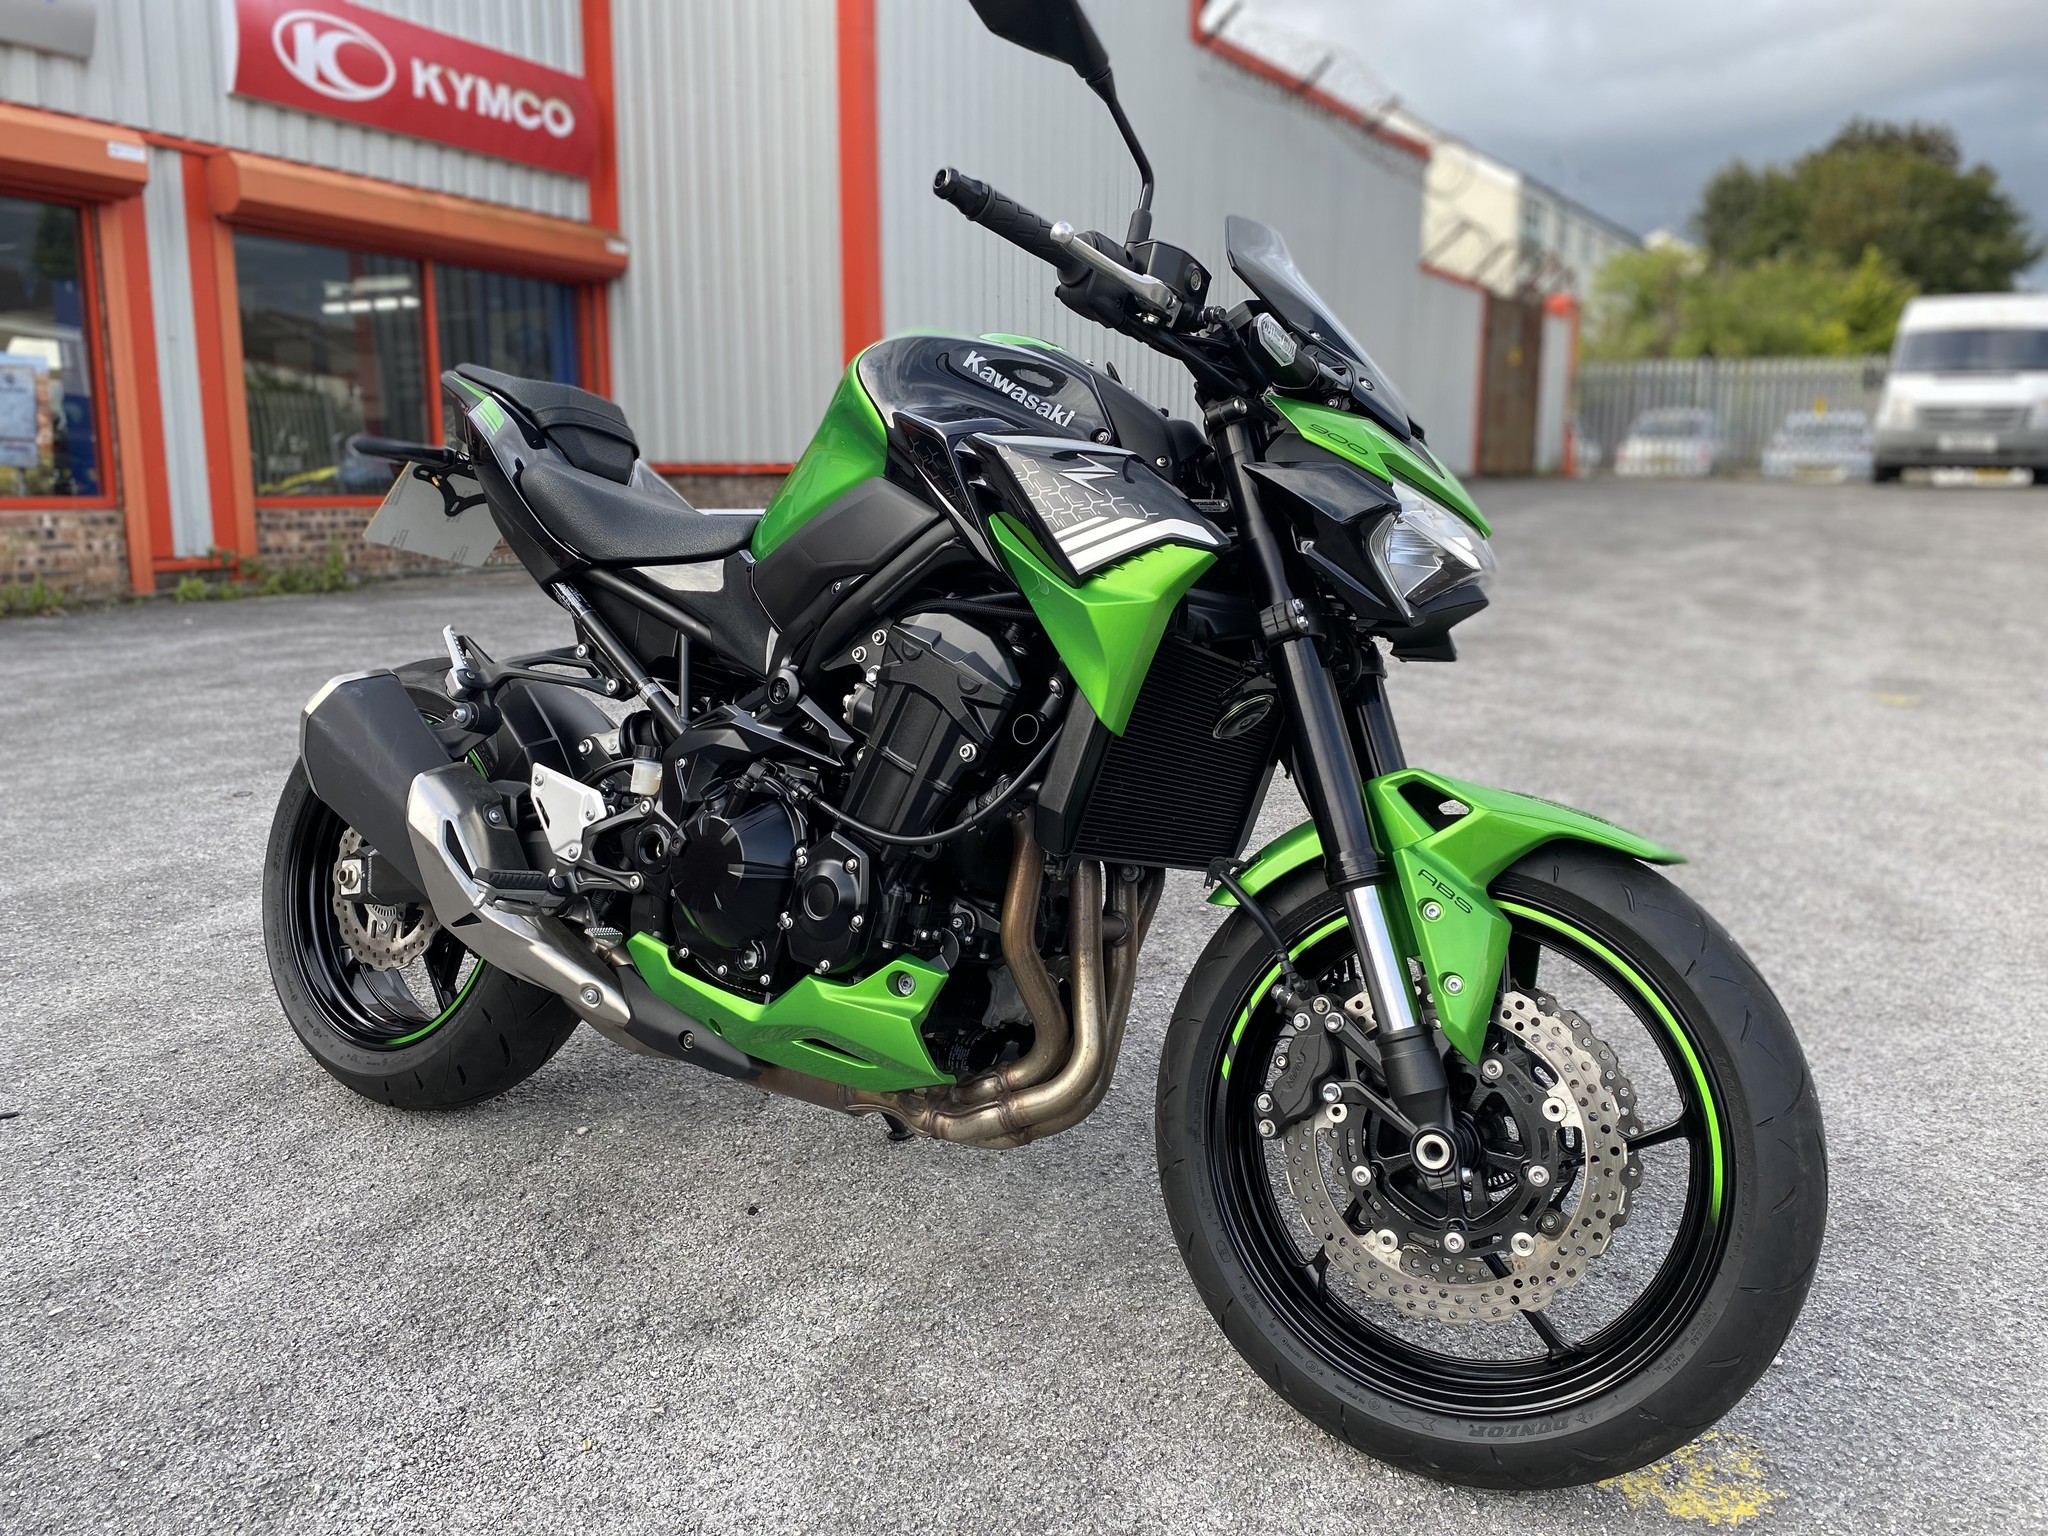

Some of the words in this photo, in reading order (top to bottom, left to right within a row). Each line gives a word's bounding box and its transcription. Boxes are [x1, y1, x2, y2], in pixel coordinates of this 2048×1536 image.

[410, 56, 576, 139] KYMCO
[962, 350, 1077, 428] Kawasaki
[1308, 423, 1369, 455] 900
[1418, 868, 1473, 914] ABS
[1662, 1352, 1686, 1373] RADIAL
[1468, 1416, 1570, 1438] DUNLOP
